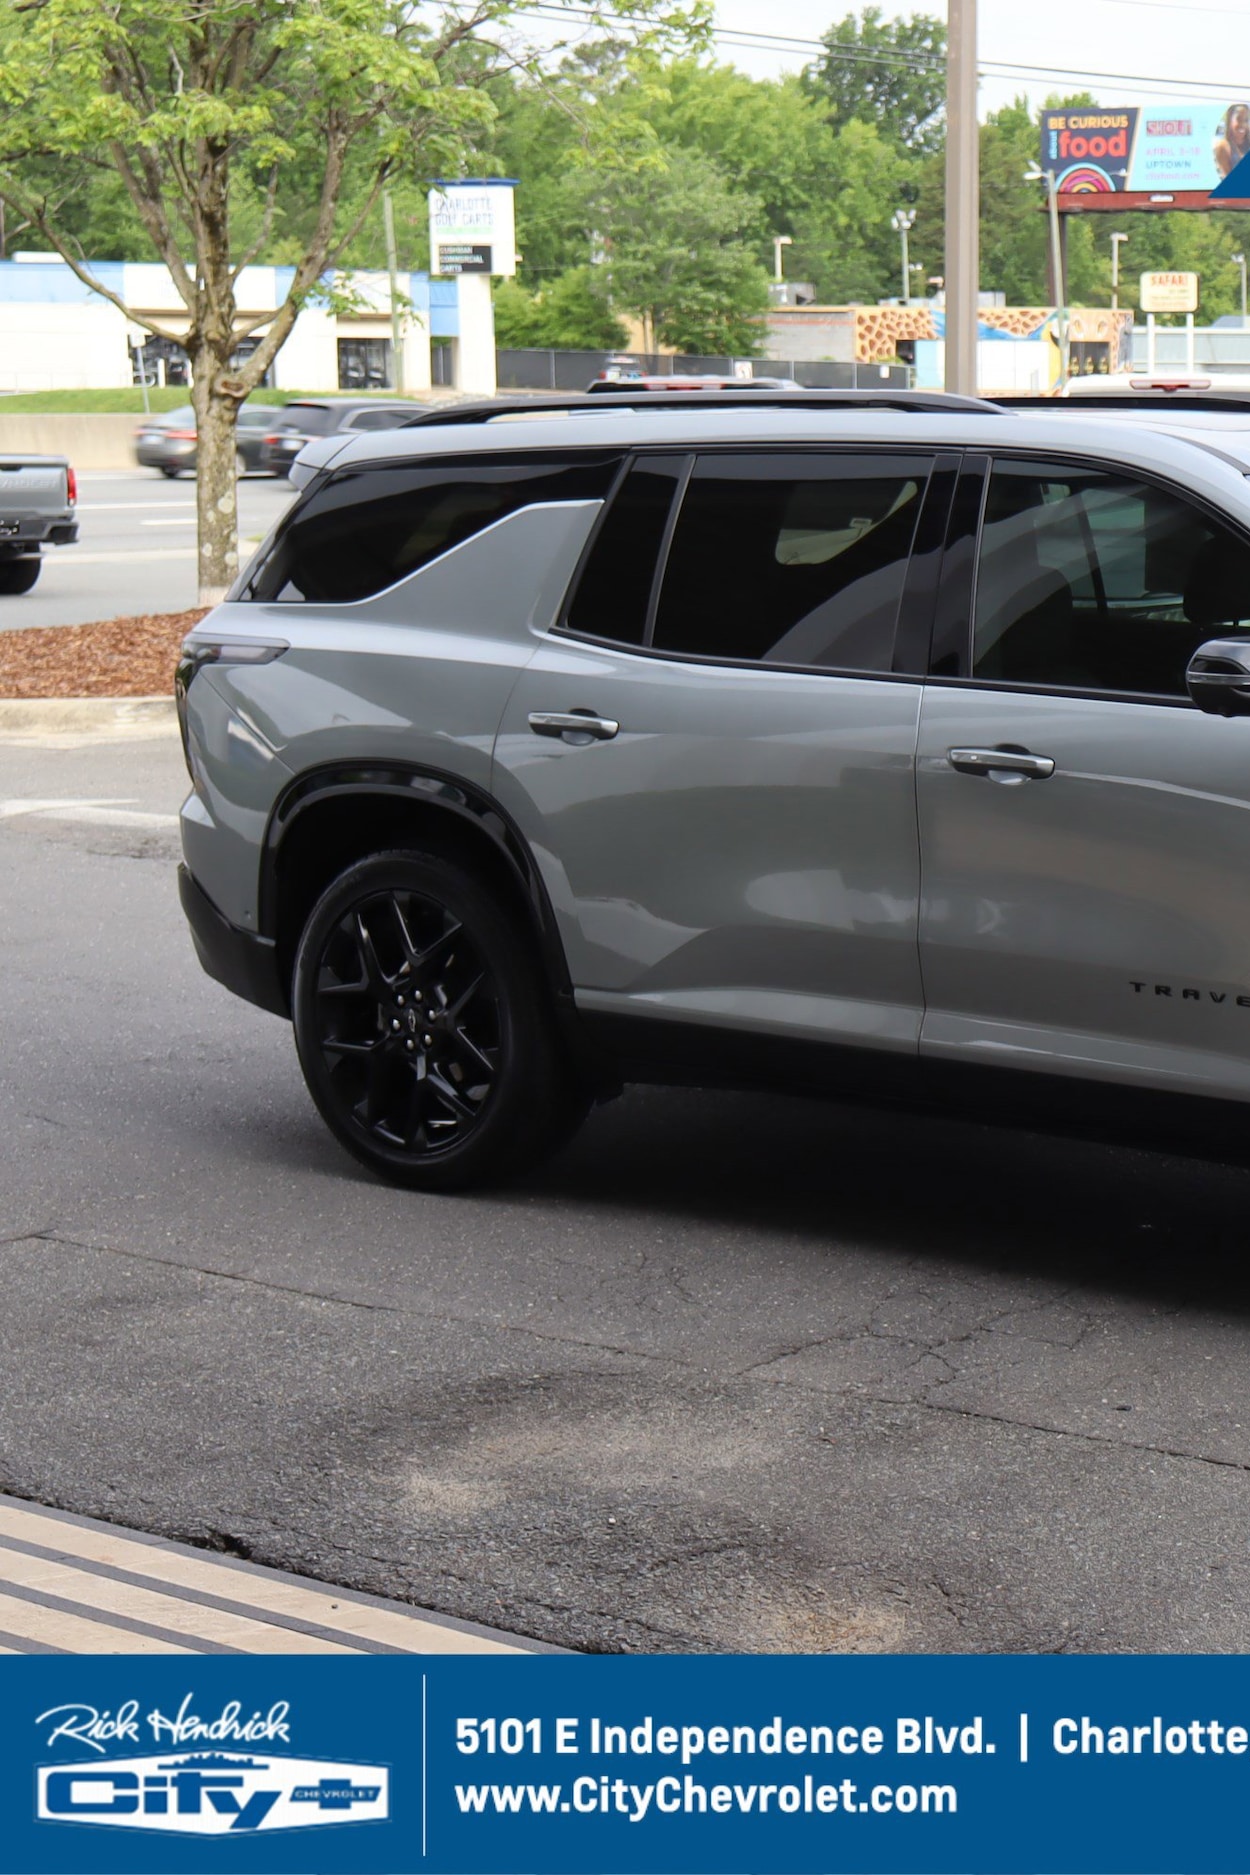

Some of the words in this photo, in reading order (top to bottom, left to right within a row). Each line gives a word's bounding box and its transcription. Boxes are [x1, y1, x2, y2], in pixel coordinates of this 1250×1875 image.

[1047, 116, 1066, 129] BE
[1068, 115, 1129, 129] CURIOUS
[1058, 129, 1128, 159] food
[1145, 159, 1192, 169] UPTOWN
[1150, 273, 1189, 286] SAFARI
